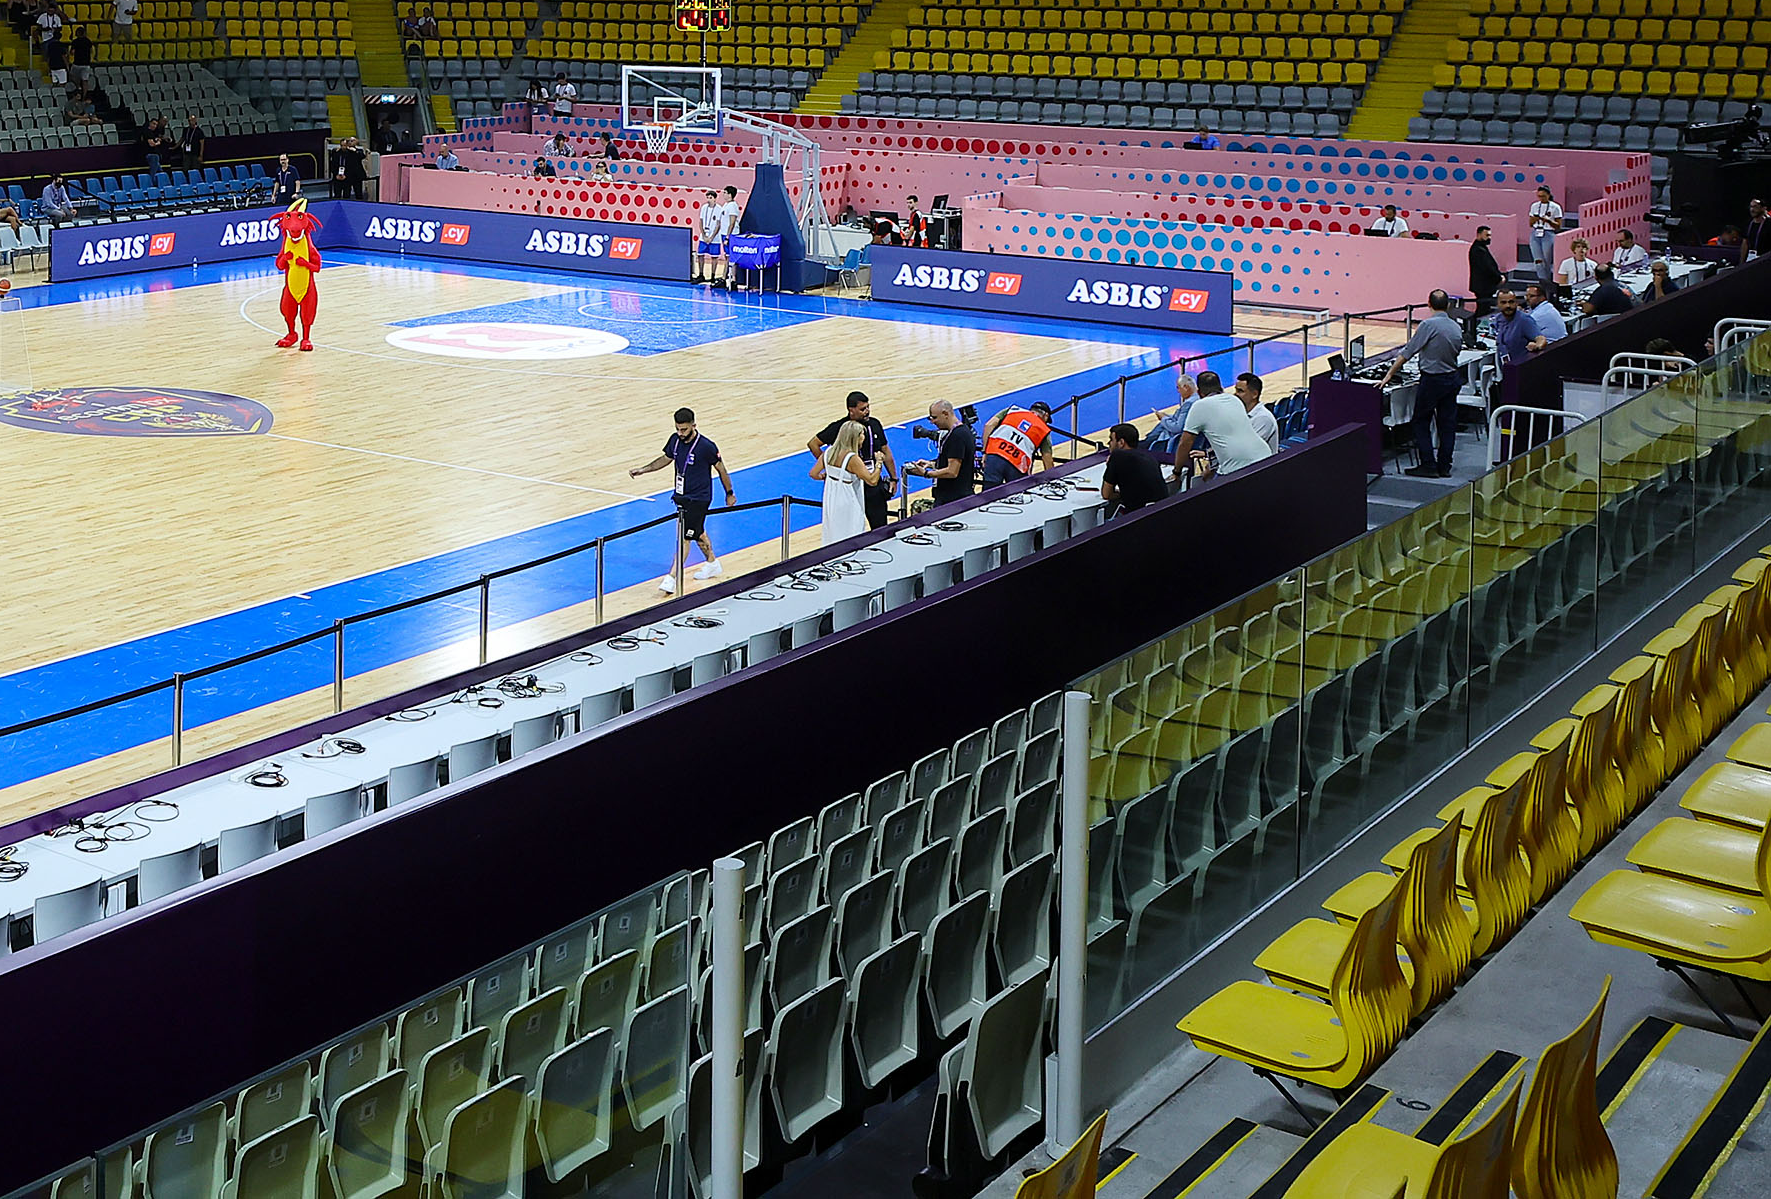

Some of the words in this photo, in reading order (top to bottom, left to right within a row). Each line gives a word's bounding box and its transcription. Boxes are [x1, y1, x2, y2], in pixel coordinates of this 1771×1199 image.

[220, 219, 281, 246] ASBIS
[365, 217, 437, 243] ASBIS
[444, 226, 465, 242] .cy
[526, 229, 606, 257] ASBIS
[613, 240, 636, 257] .cy
[78, 235, 145, 265] ASBIS
[152, 237, 171, 250] .cy
[893, 264, 981, 292] ASBIS
[990, 275, 1016, 294] .cy
[1067, 279, 1165, 309] ASBIS
[1174, 293, 1202, 310] .cy
[1010, 431, 1024, 445] TV
